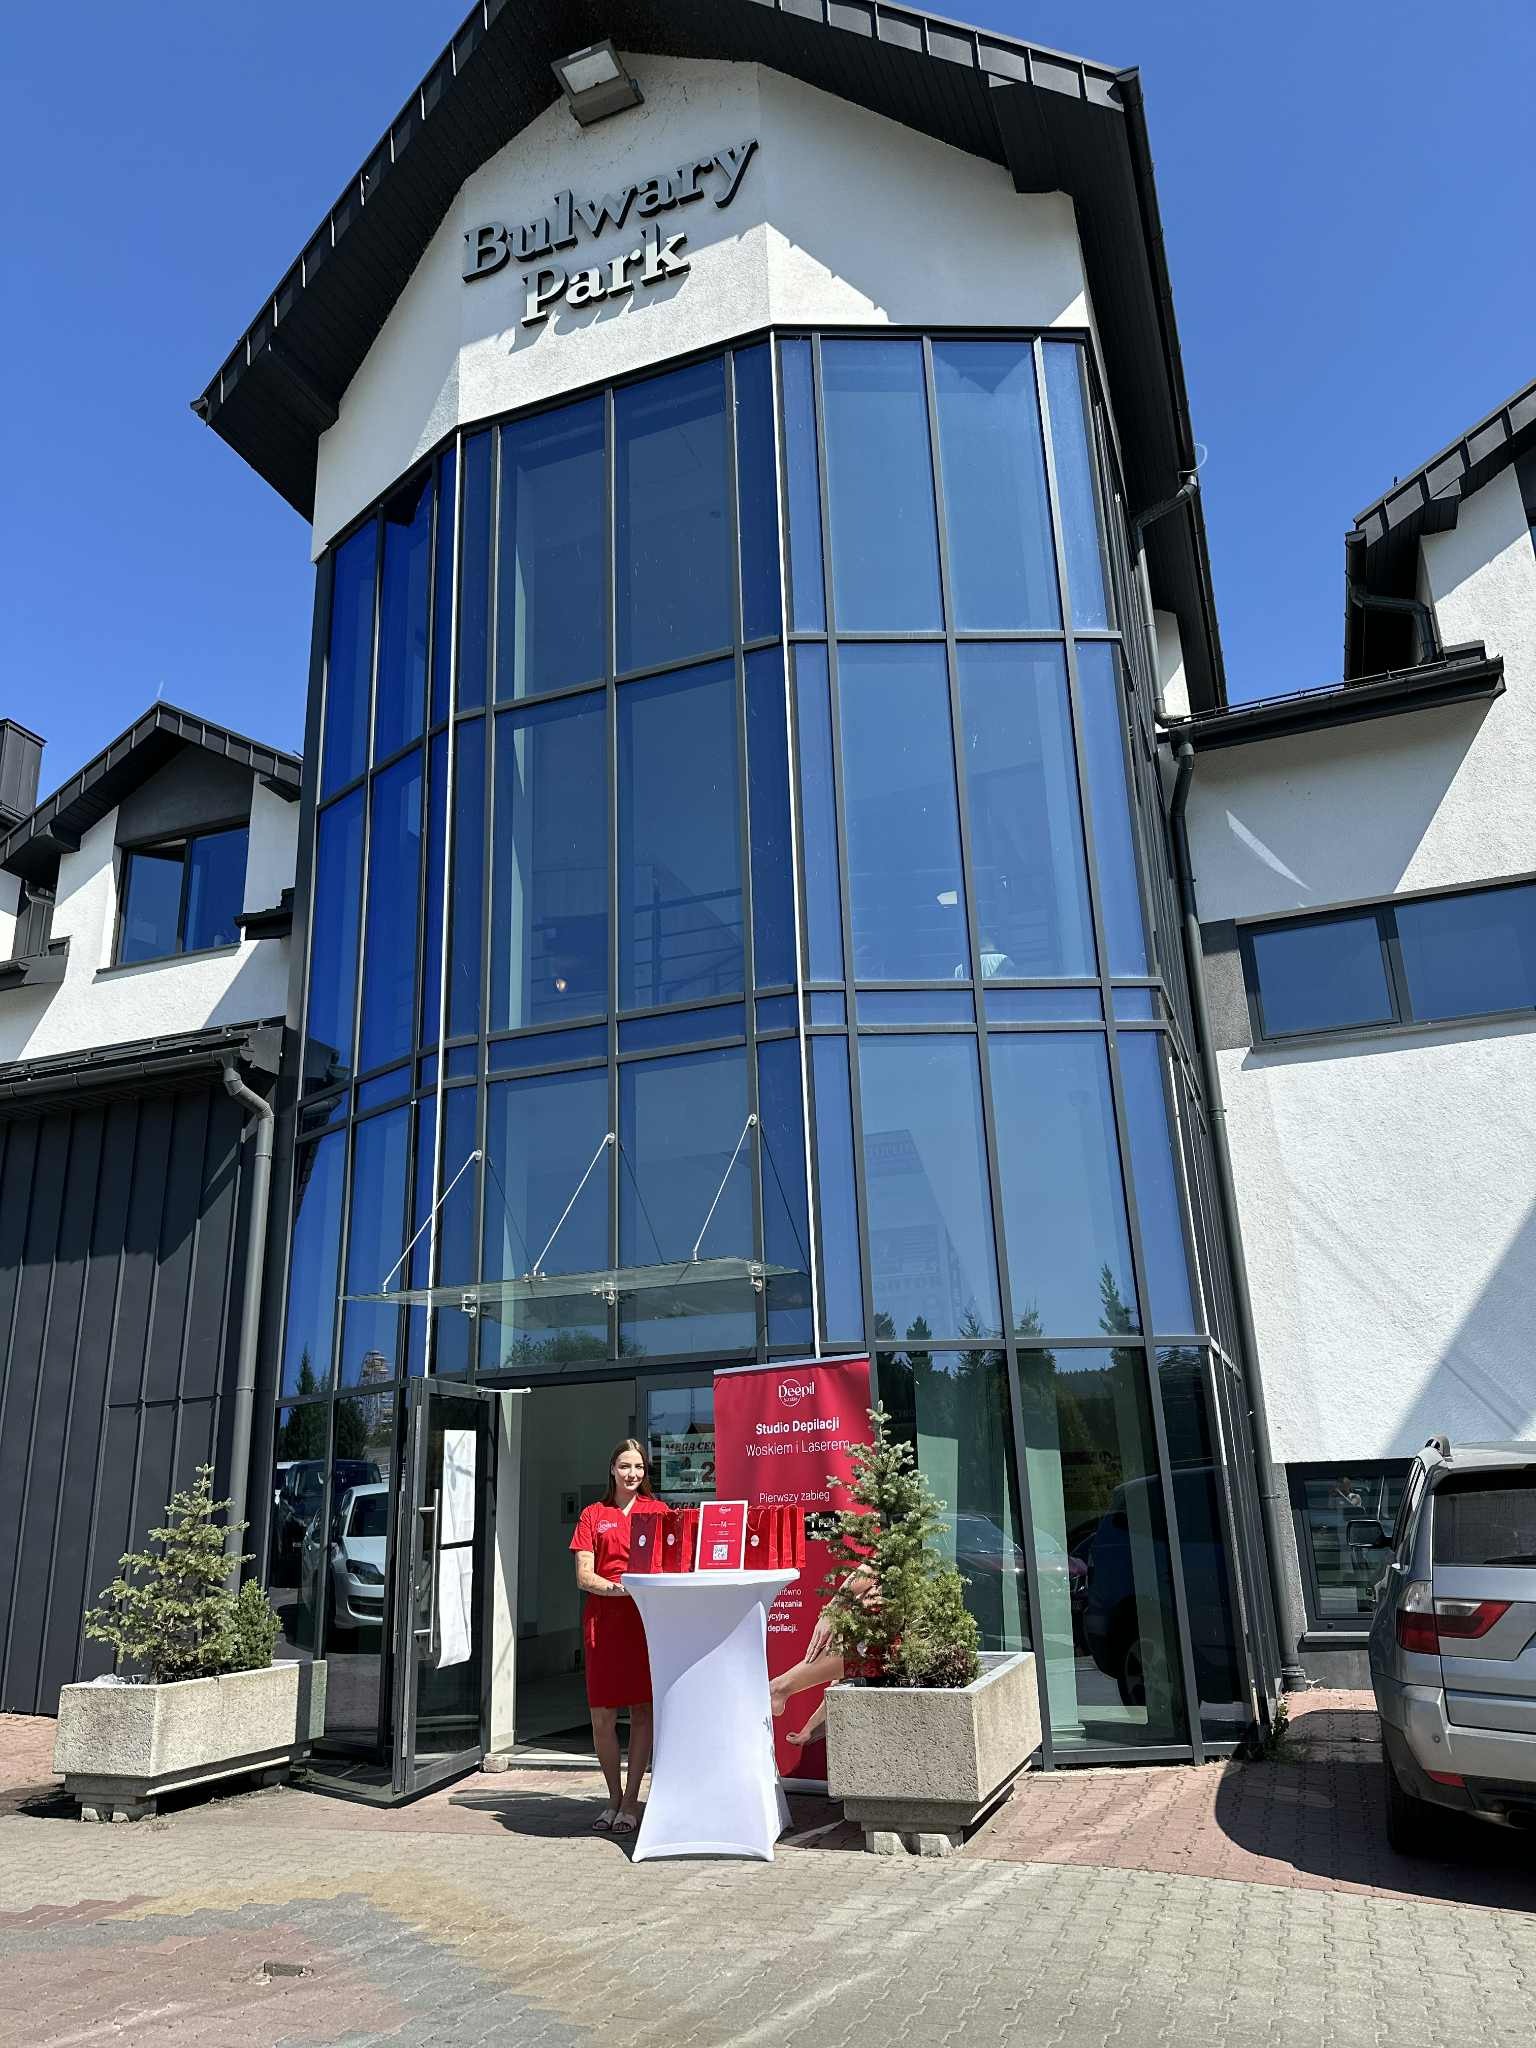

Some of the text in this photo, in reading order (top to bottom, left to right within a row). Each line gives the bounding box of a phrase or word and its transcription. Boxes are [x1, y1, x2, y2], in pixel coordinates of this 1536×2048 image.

[462, 138, 759, 283] Bulwary
[521, 223, 691, 327] Park
[778, 1381, 815, 1398] Deepil
[755, 1416, 840, 1435] Studio Depilacji
[745, 1439, 850, 1457] Woskiem i Laserem
[759, 1490, 830, 1504] Pierwszy zabieg
